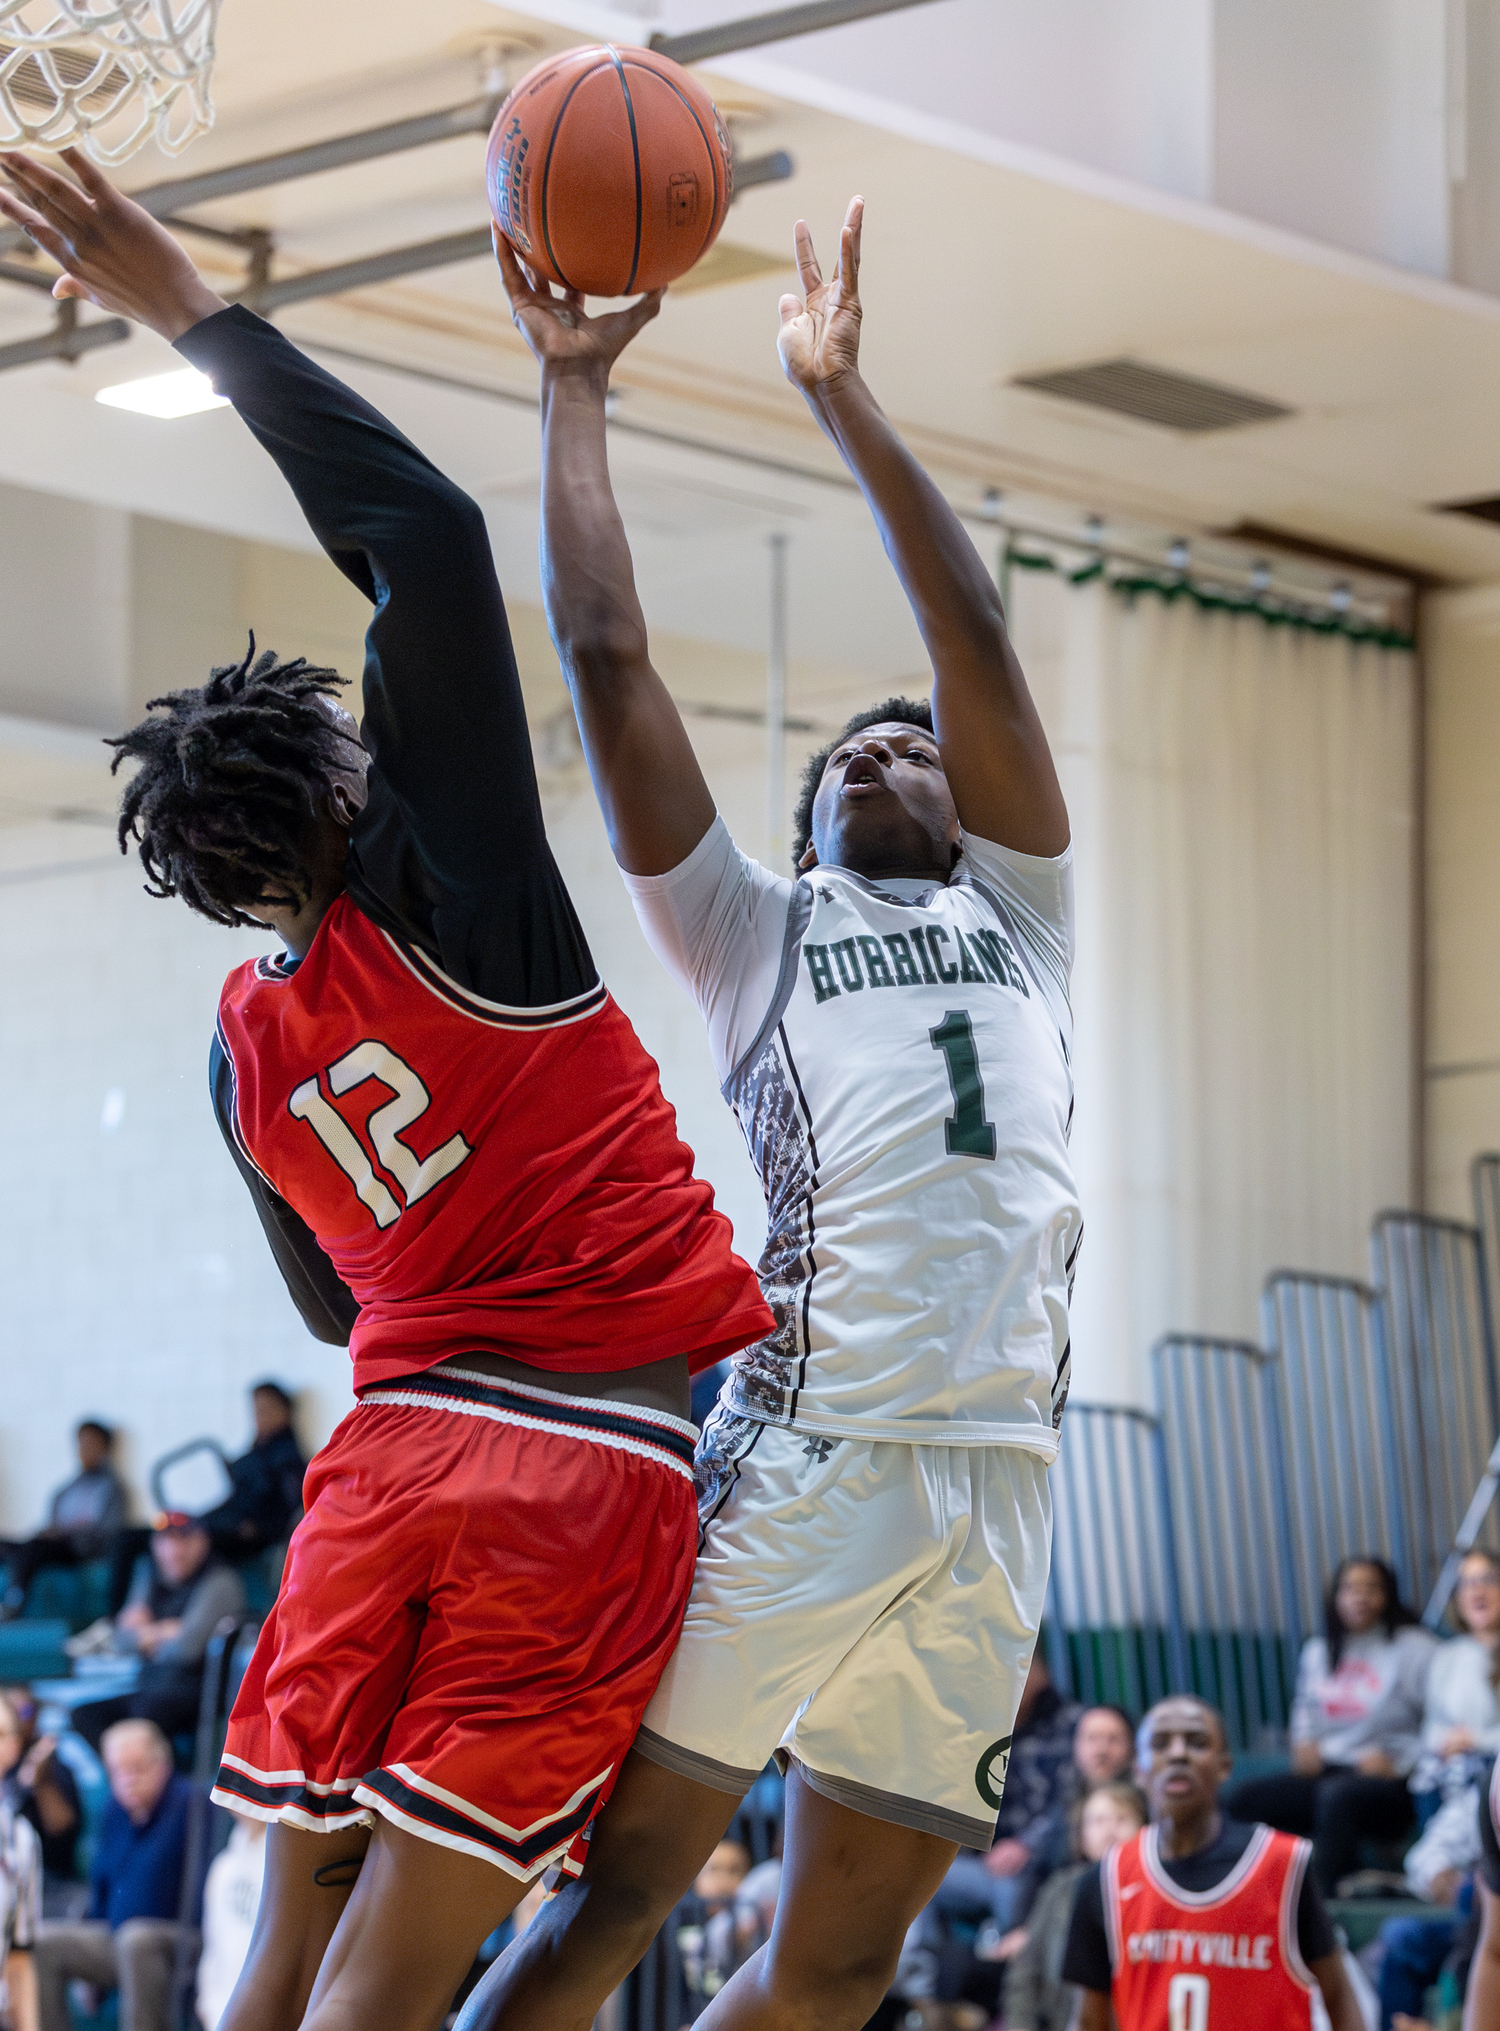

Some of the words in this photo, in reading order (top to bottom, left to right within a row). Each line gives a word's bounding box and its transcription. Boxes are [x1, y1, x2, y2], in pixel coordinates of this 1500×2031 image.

[497, 117, 520, 248] EGACY
[287, 1038, 475, 1231] 12
[928, 1009, 998, 1161] 1
[1168, 1972, 1211, 2031] 0
